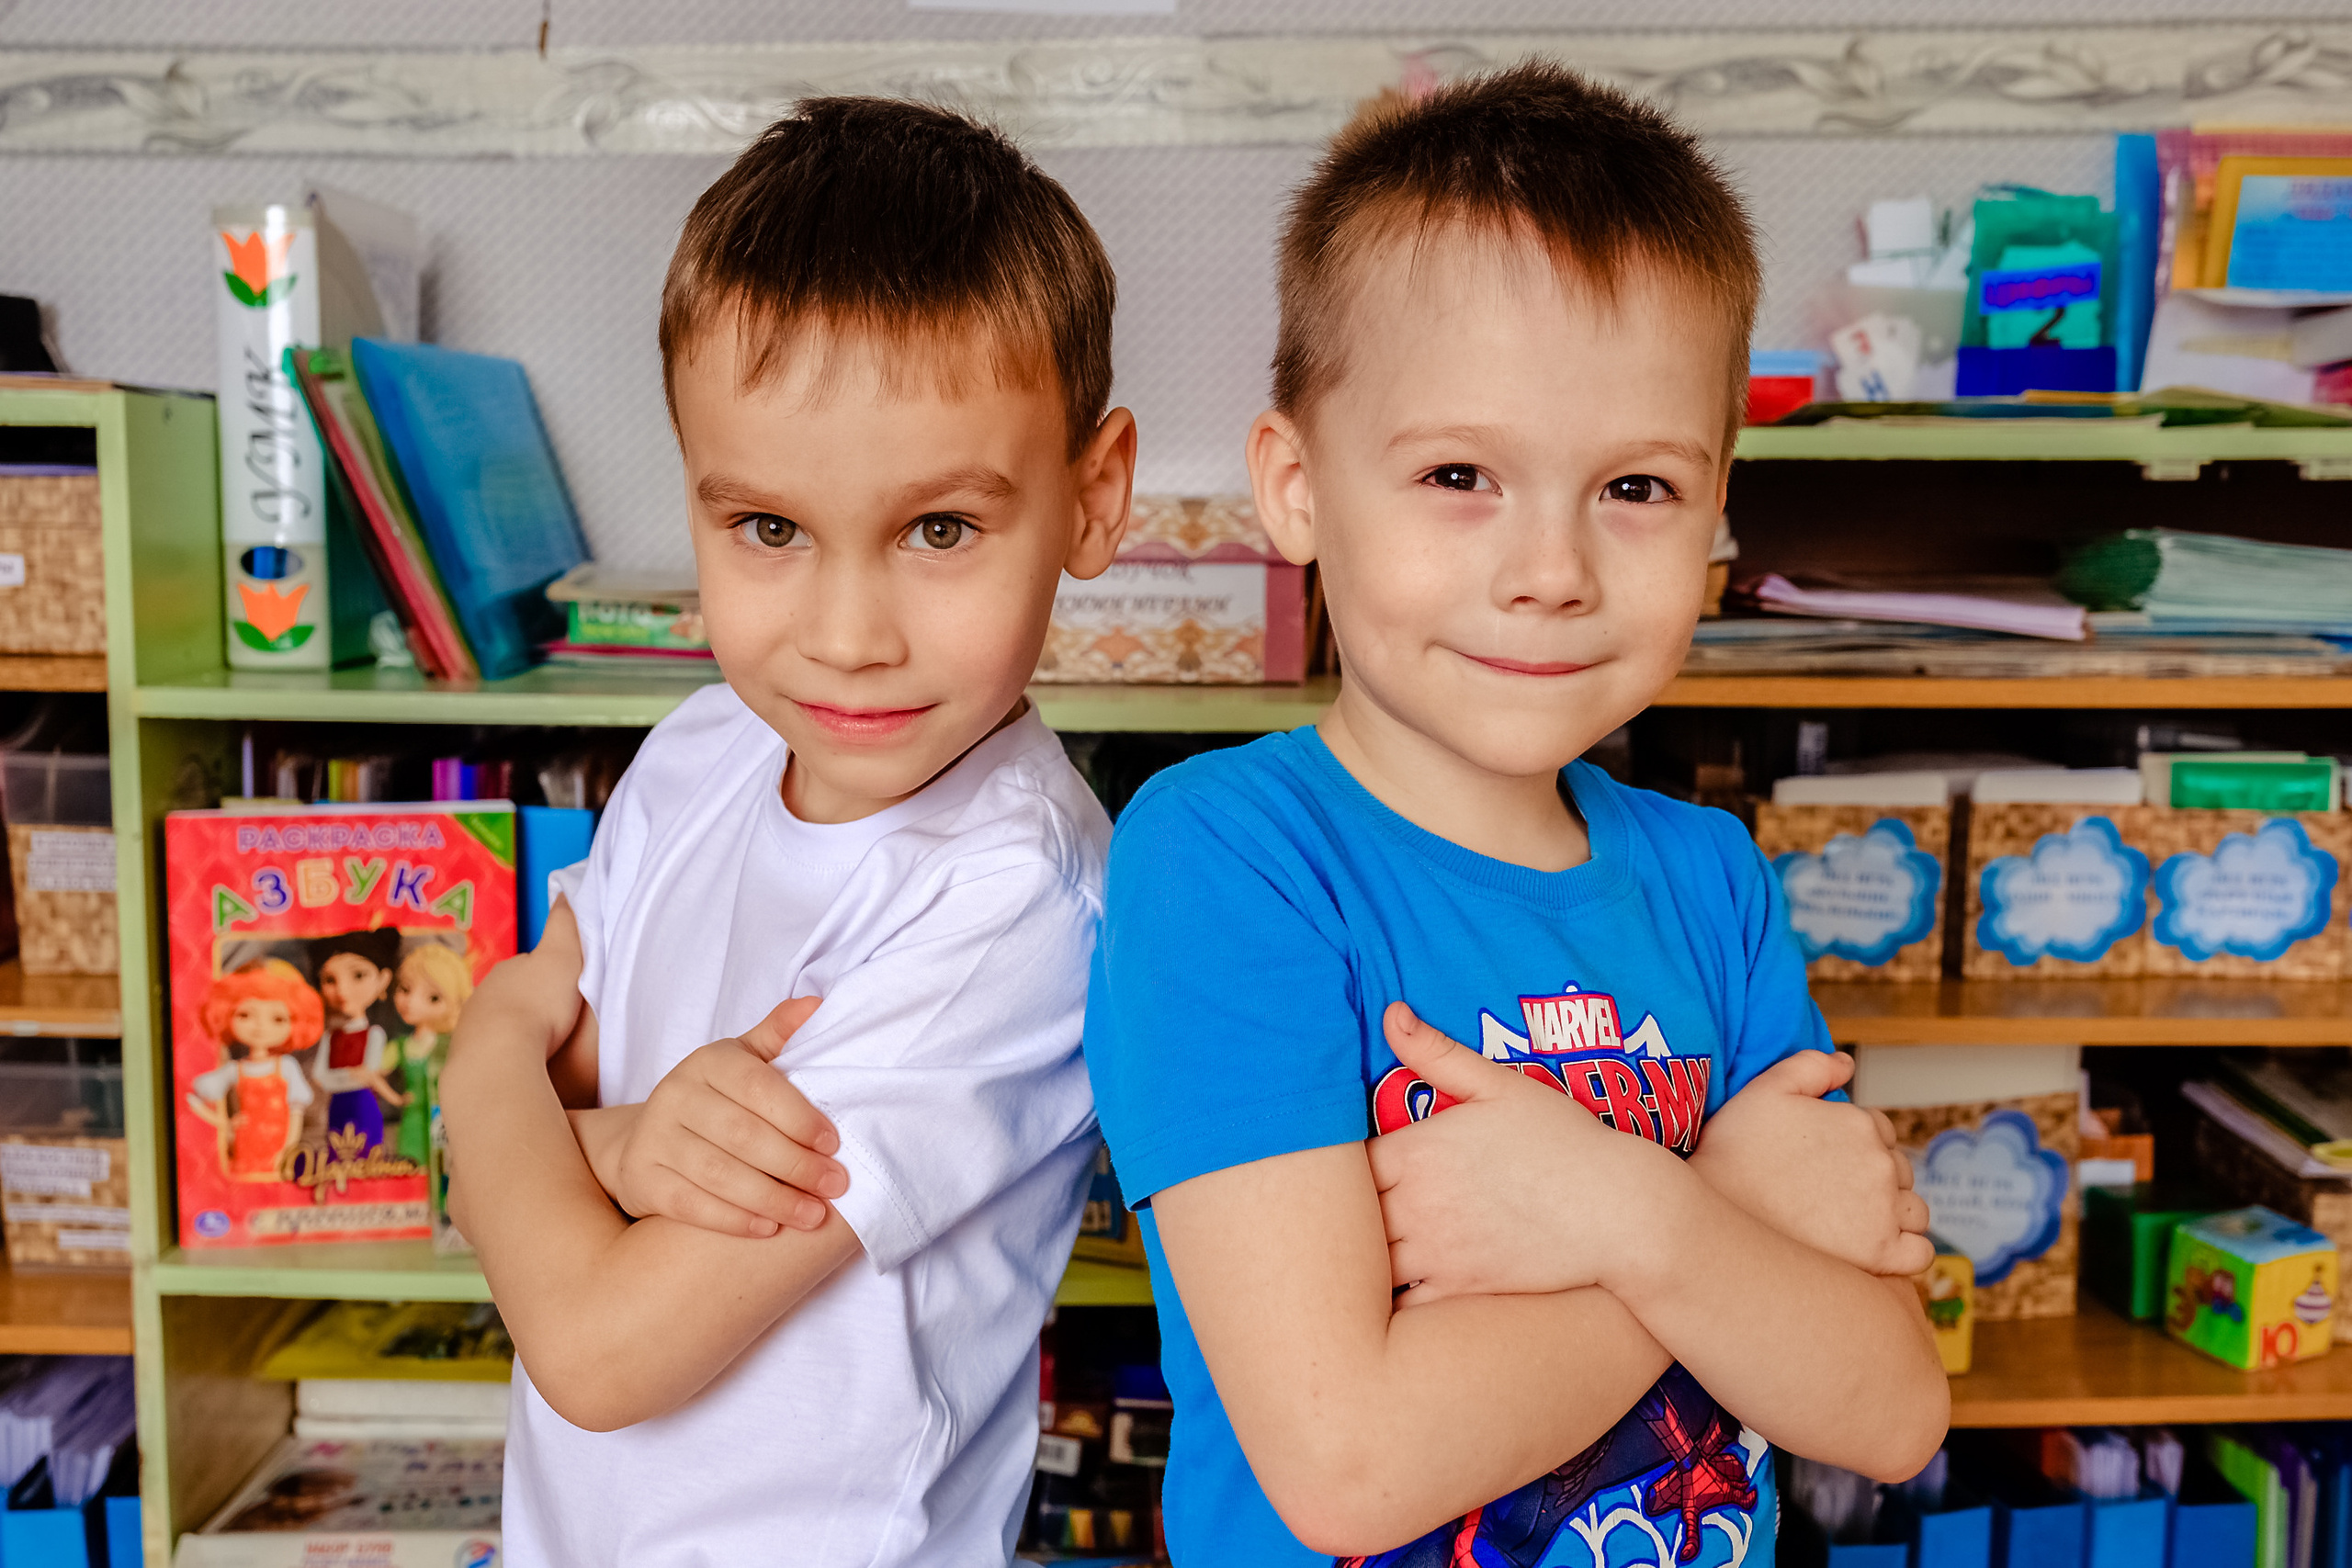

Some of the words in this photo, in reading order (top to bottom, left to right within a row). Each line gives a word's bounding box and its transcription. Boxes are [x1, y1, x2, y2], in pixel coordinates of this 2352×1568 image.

[236, 821, 446, 852] РАСКРАСКА
[212, 857, 474, 934] АЗБУКА
[1522, 998, 1621, 1051] MARVEL
